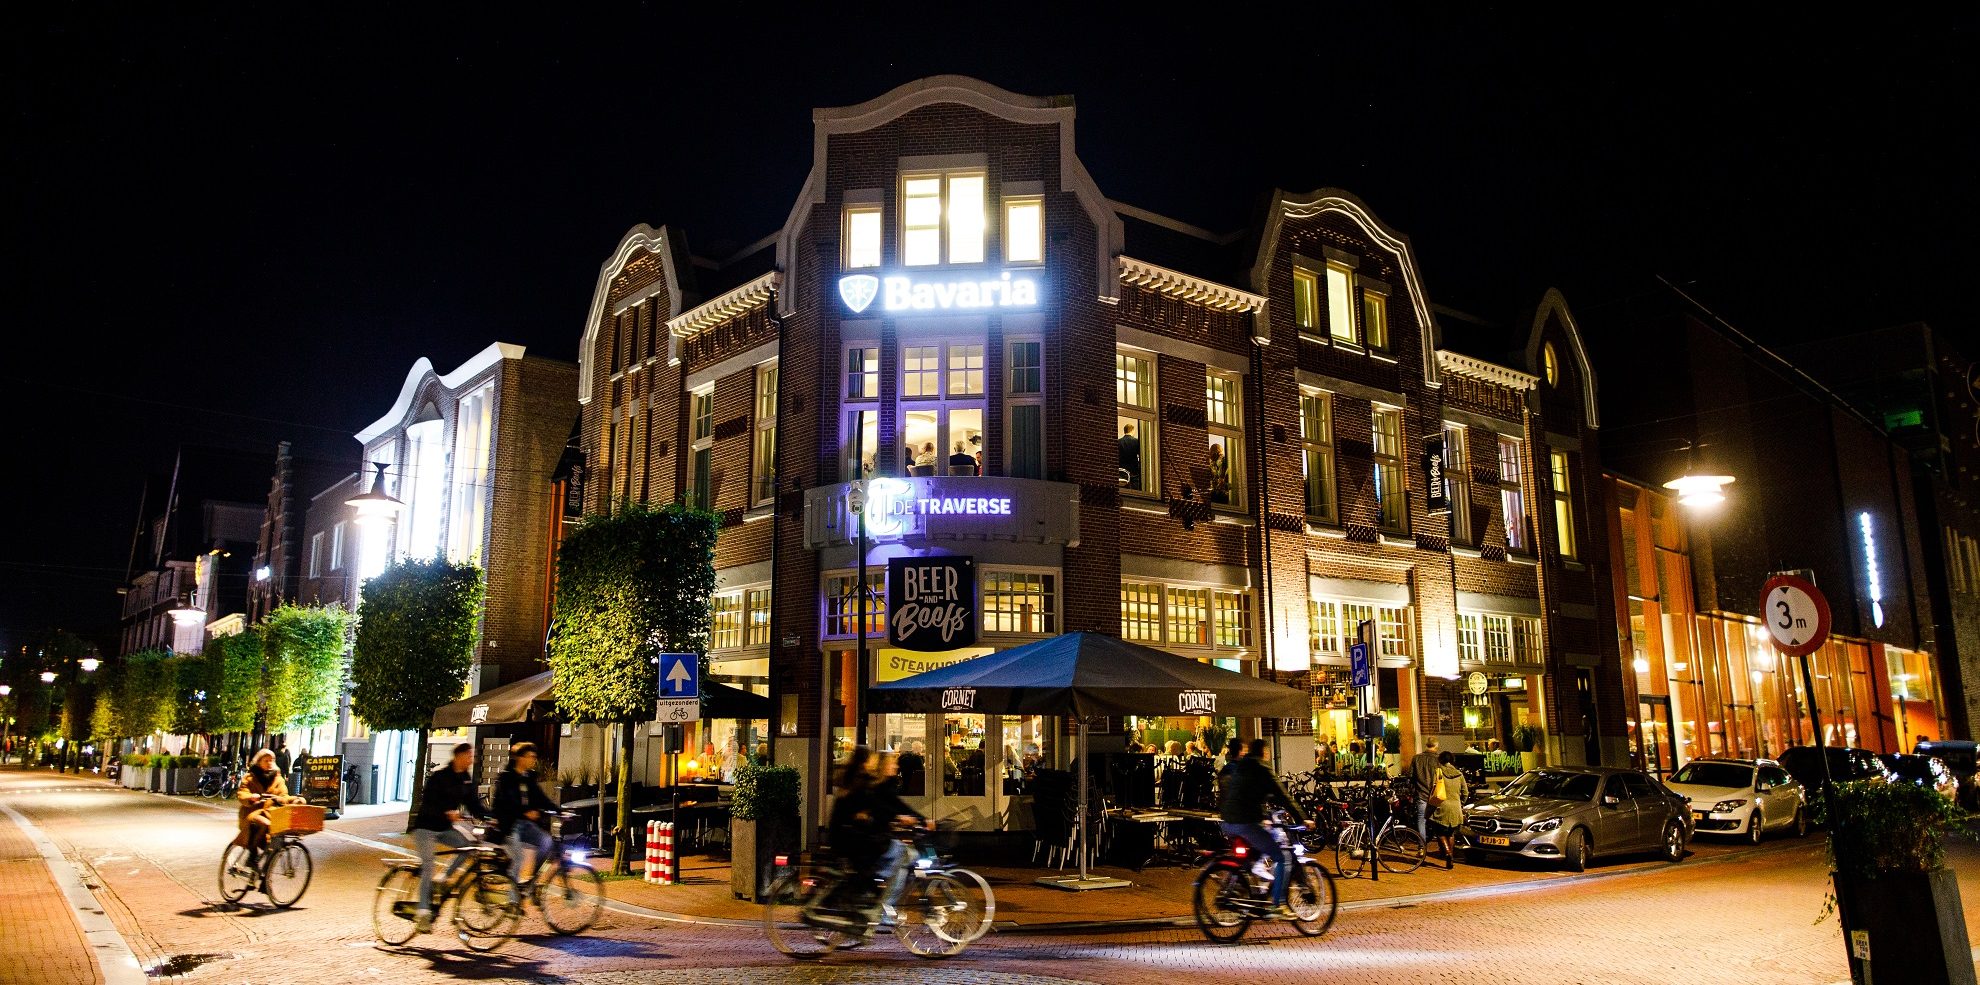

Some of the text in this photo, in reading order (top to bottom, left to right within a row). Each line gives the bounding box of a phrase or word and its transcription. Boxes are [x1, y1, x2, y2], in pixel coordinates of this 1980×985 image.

[884, 272, 1037, 311] Bavaria
[894, 498, 1012, 515] DE TRAVERSE
[904, 566, 959, 601] BEER
[924, 595, 938, 604] AND
[891, 602, 970, 642] Beefs
[1776, 601, 1807, 630] 3 m
[889, 654, 980, 673] STEAKH
[1353, 648, 1363, 670] P
[659, 700, 699, 708] uitgezonderd
[942, 689, 977, 709] CORNET
[1178, 693, 1217, 713] CORNET
[306, 757, 339, 765] CASINO
